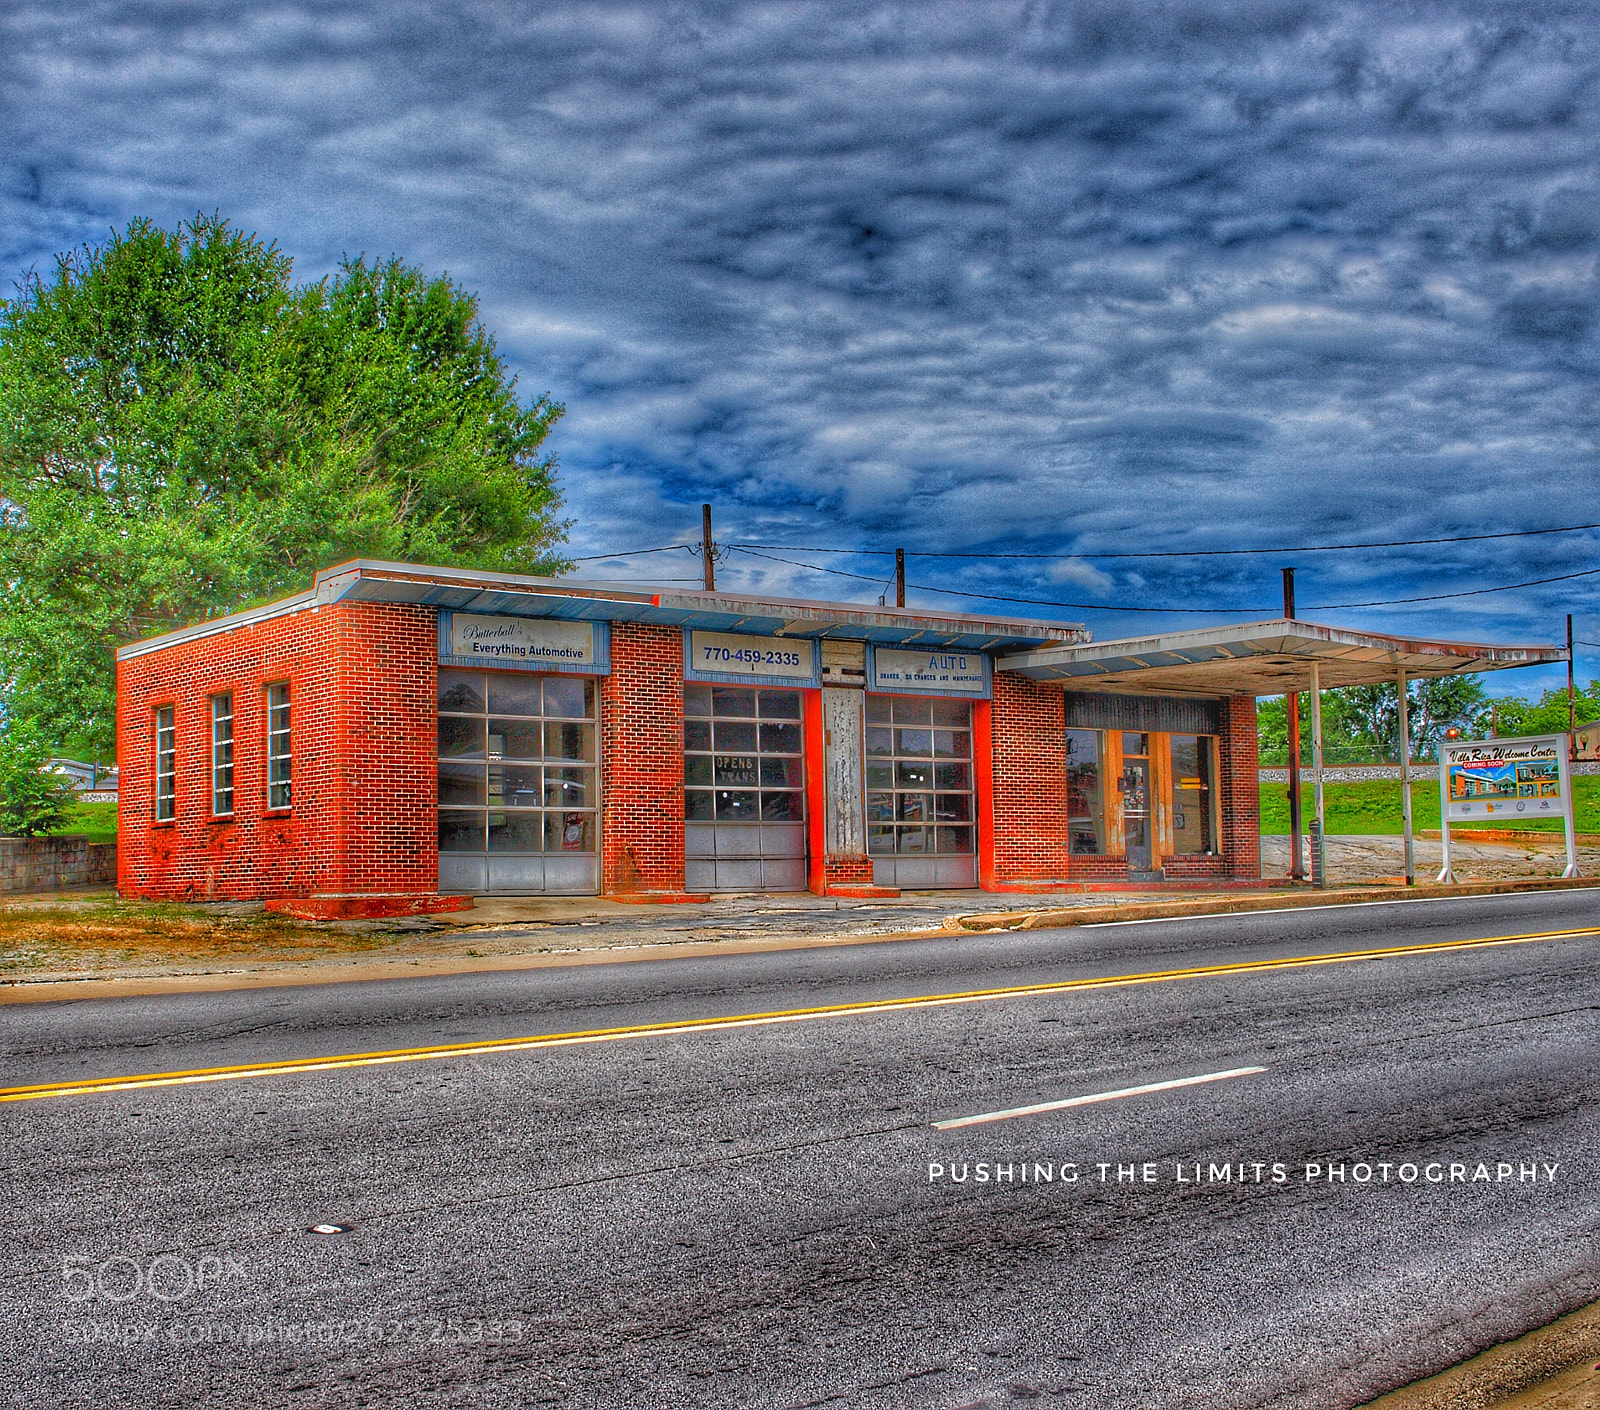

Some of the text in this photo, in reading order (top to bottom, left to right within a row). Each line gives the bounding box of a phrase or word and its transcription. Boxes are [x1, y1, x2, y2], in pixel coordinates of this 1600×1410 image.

[463, 621, 522, 639] Butterball's
[473, 642, 583, 658] Everything Automotive
[704, 647, 799, 666] 770-459-2335
[929, 656, 967, 670] AUTO
[1450, 744, 1556, 762] Villa Rica Welcome Center
